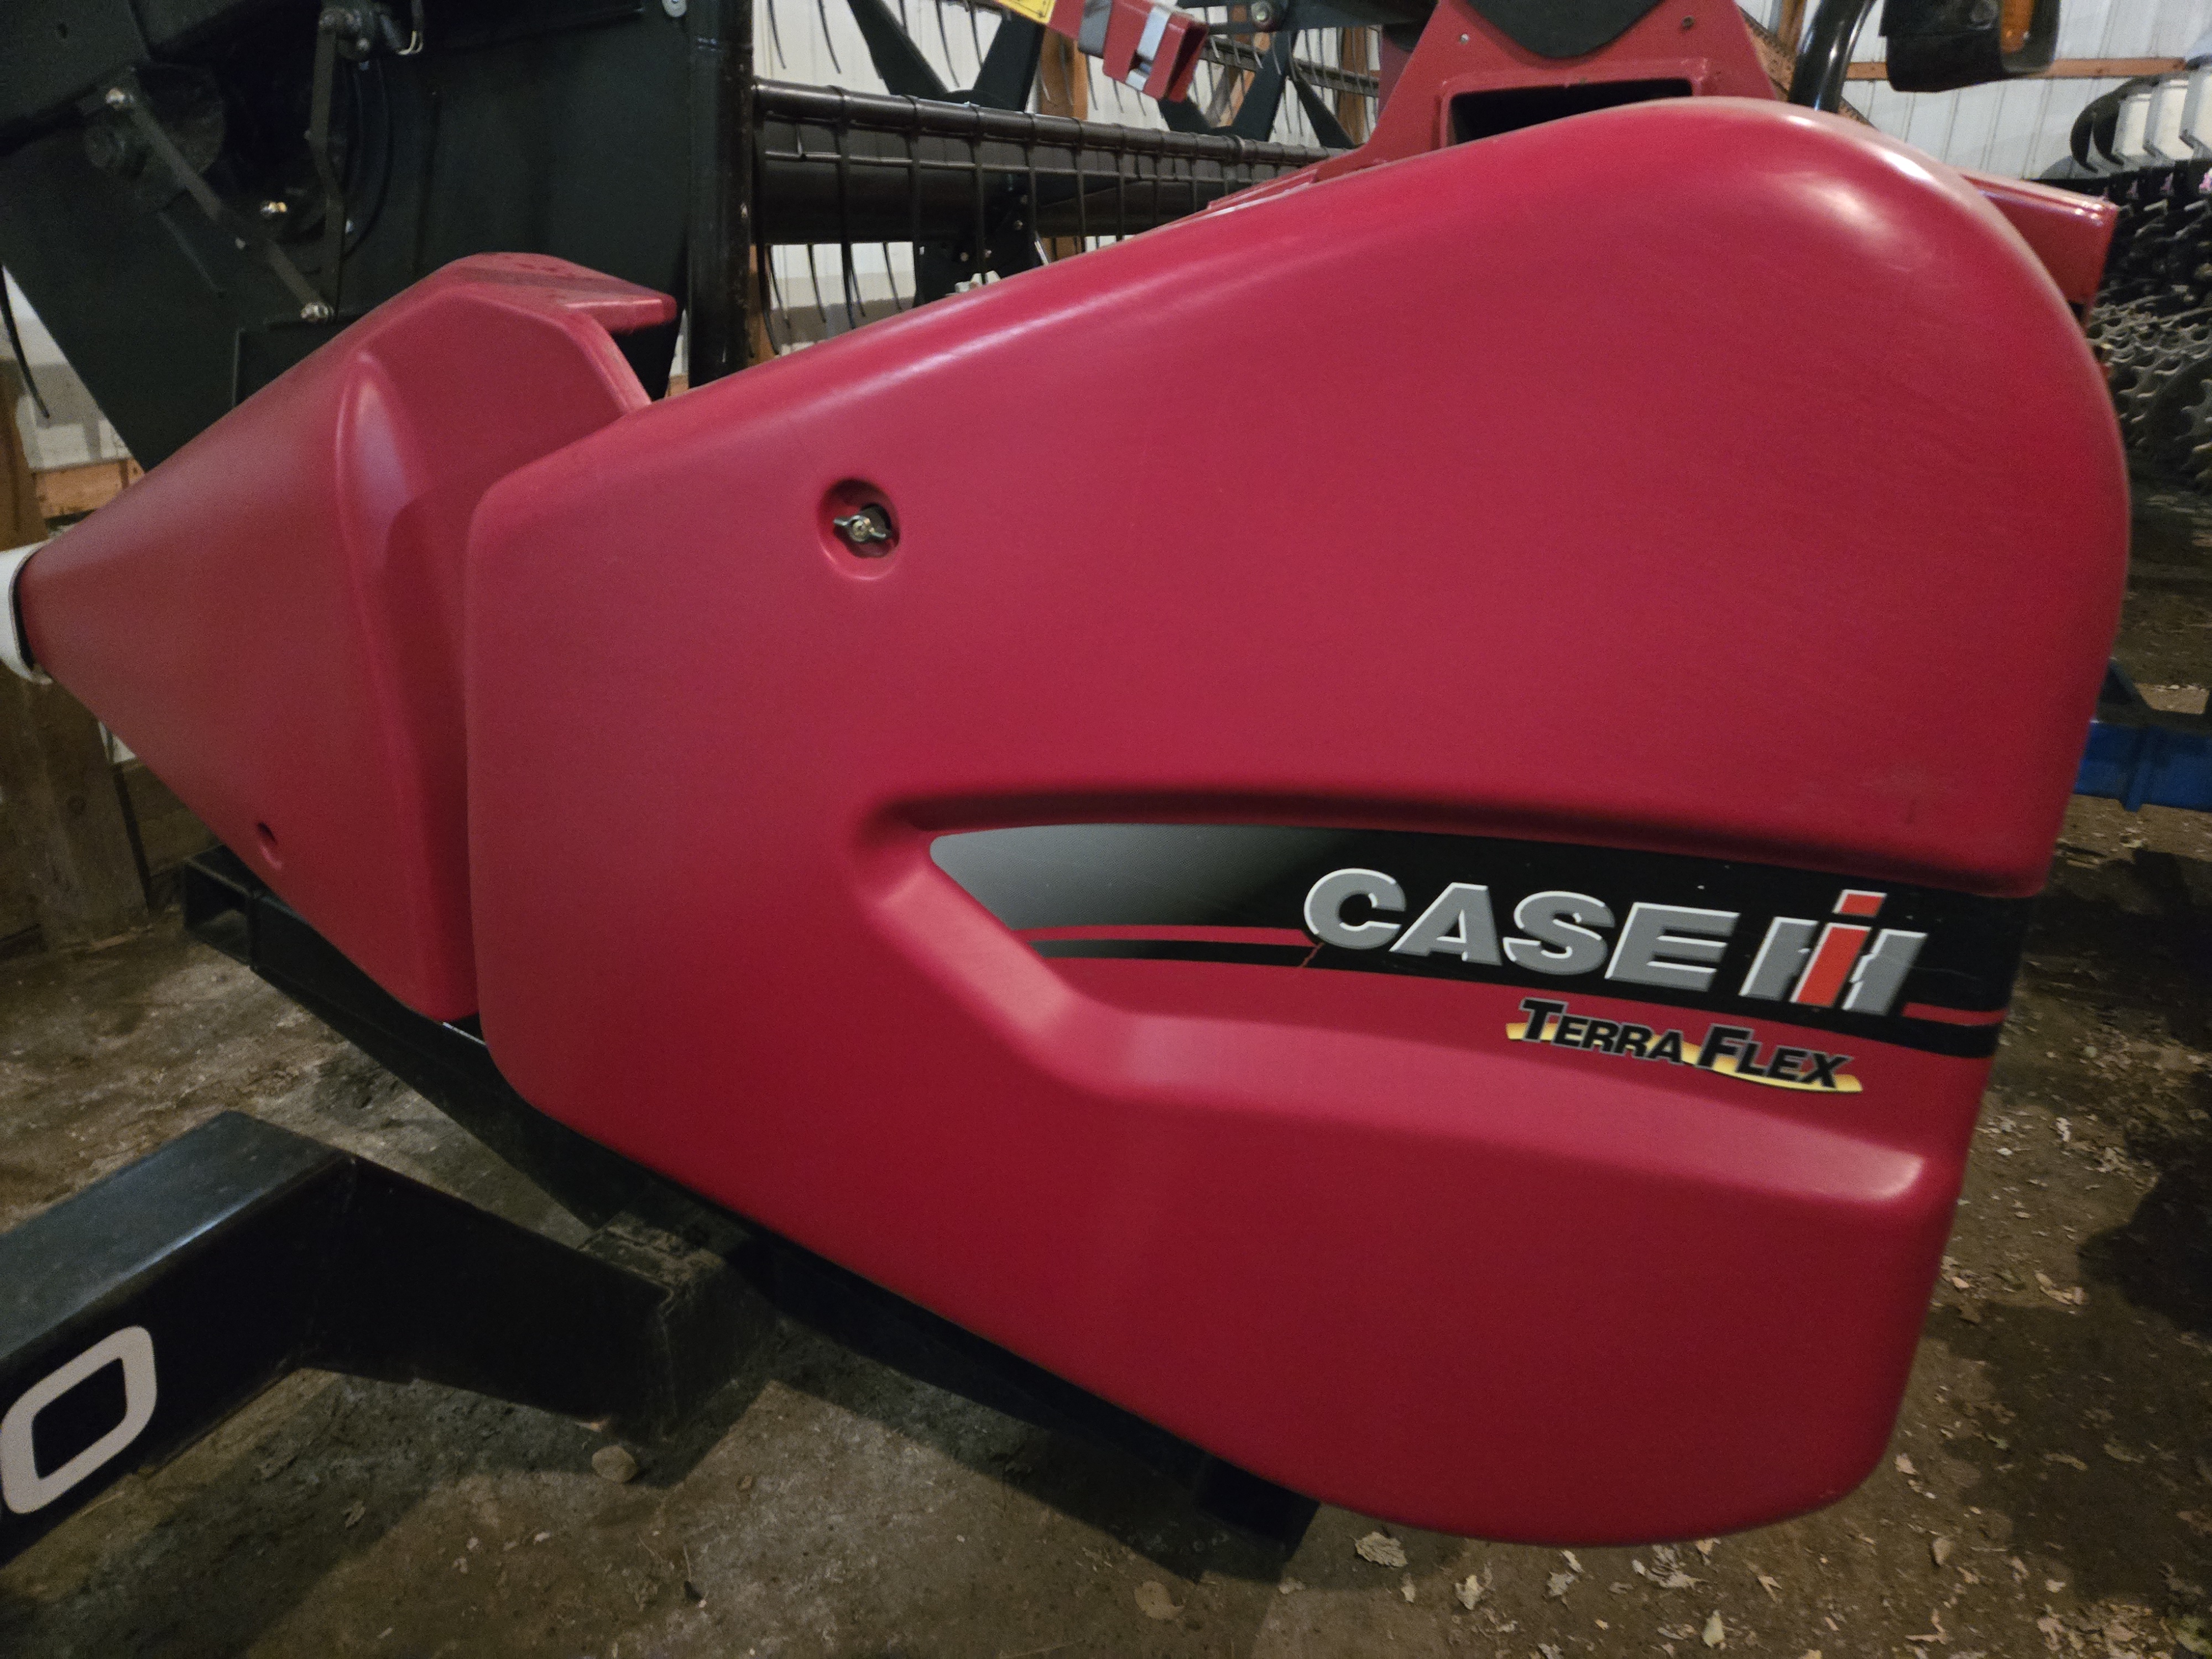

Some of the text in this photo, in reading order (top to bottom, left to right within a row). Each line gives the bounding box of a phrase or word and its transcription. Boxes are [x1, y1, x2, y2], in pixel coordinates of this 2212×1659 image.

[1303, 868, 1741, 992] CASE
[1519, 998, 1854, 1089] TERRA FLEX
